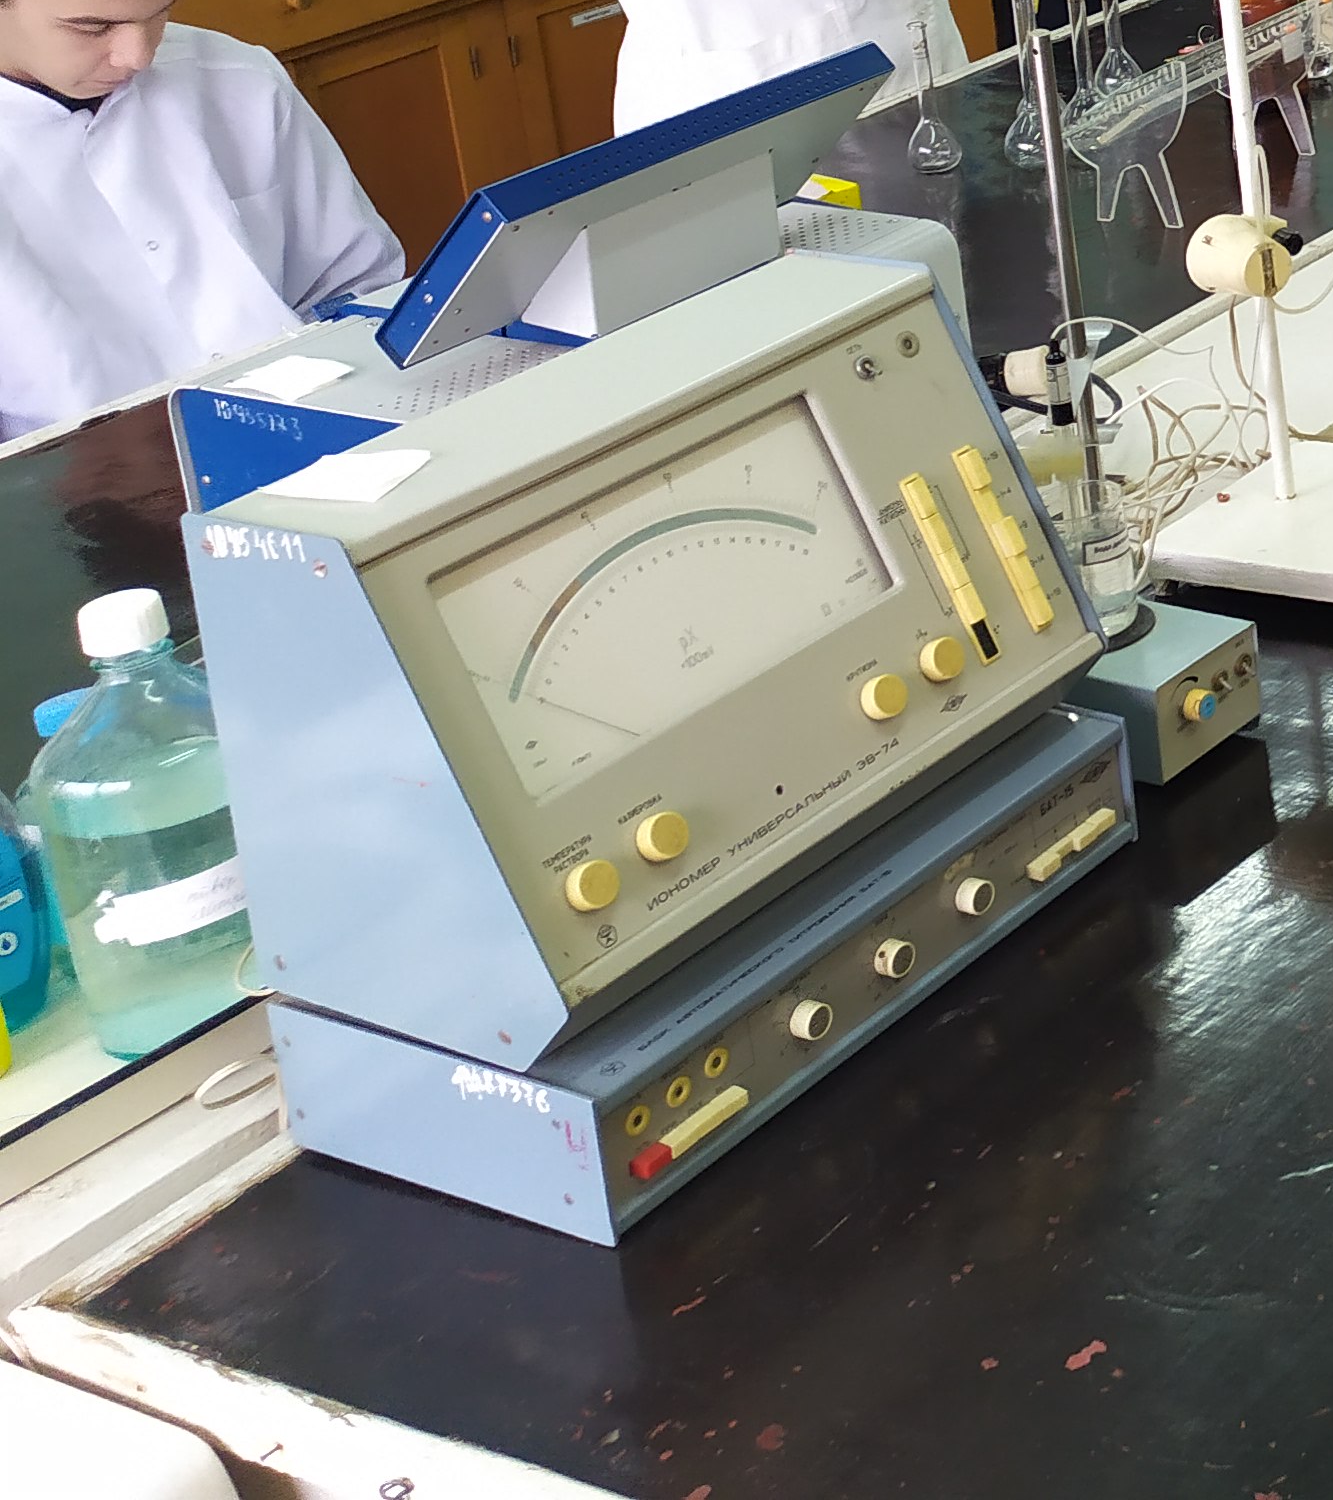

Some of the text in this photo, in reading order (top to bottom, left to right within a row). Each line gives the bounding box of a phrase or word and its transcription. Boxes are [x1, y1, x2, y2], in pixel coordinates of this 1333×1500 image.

[646, 738, 899, 911] ИОНОМЕР УНИВЕРСАЛЬНЫЙ ЭВ-74
[1040, 784, 1075, 817] БАТ-15
